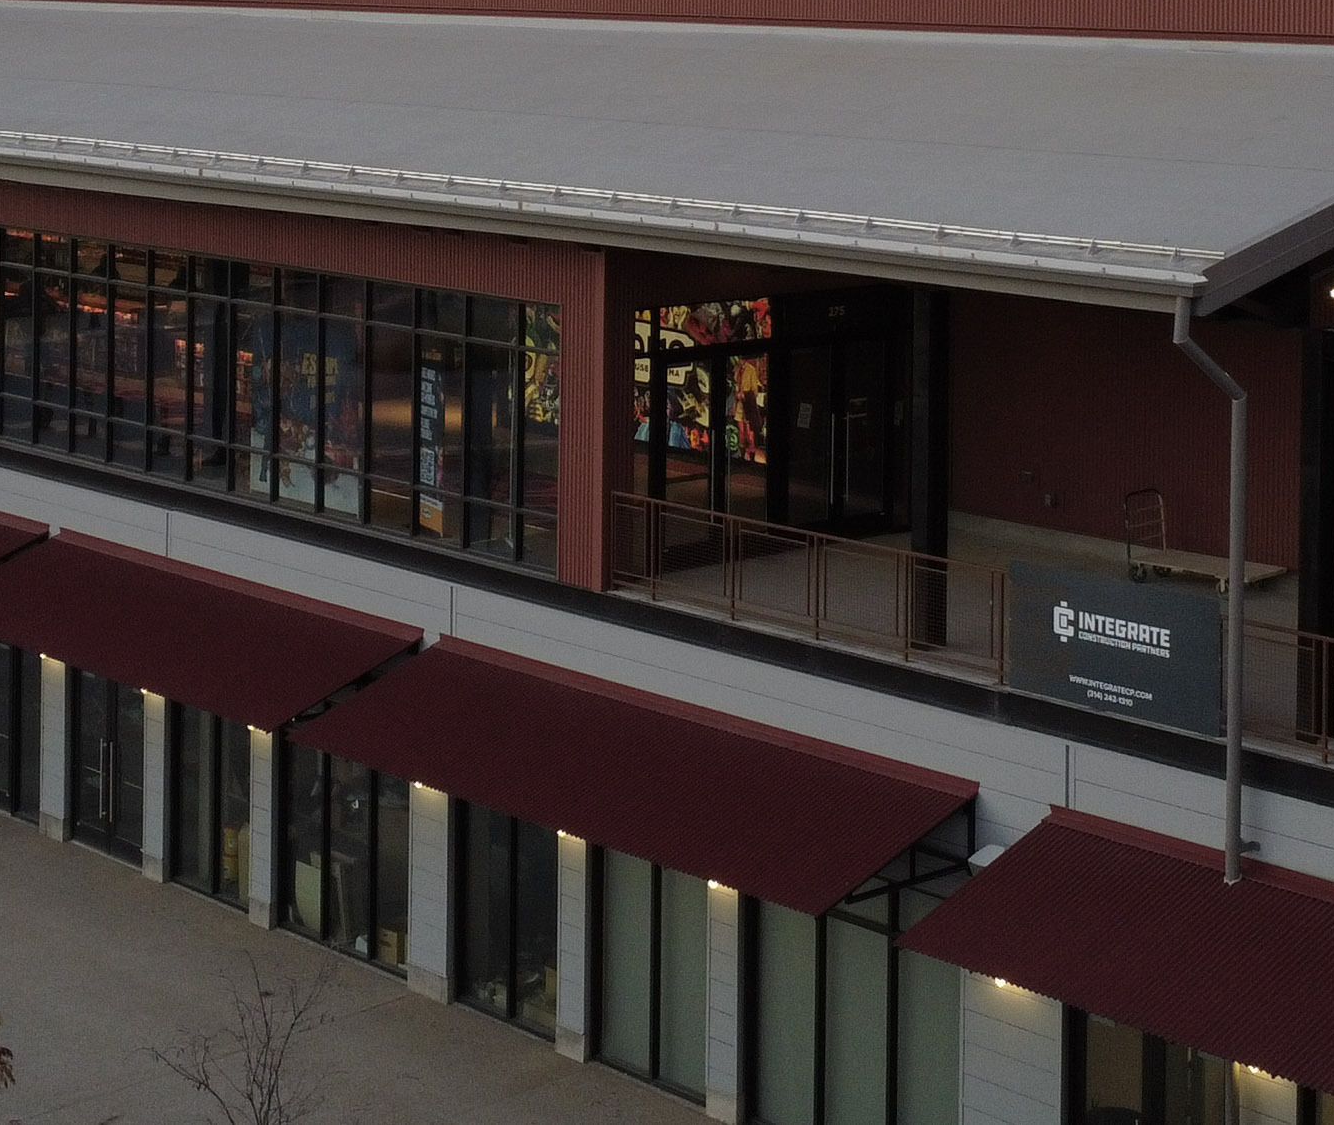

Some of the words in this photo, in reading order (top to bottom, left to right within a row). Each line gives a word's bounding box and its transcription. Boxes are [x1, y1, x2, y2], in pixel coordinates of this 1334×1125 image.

[1078, 611, 1170, 647] INTEGRATE
[1078, 631, 1131, 650] CONSTRUCTION
[1132, 642, 1170, 658] PARTNERS
[1069, 675, 1152, 700] WWW.INTEGRATECP.COM
